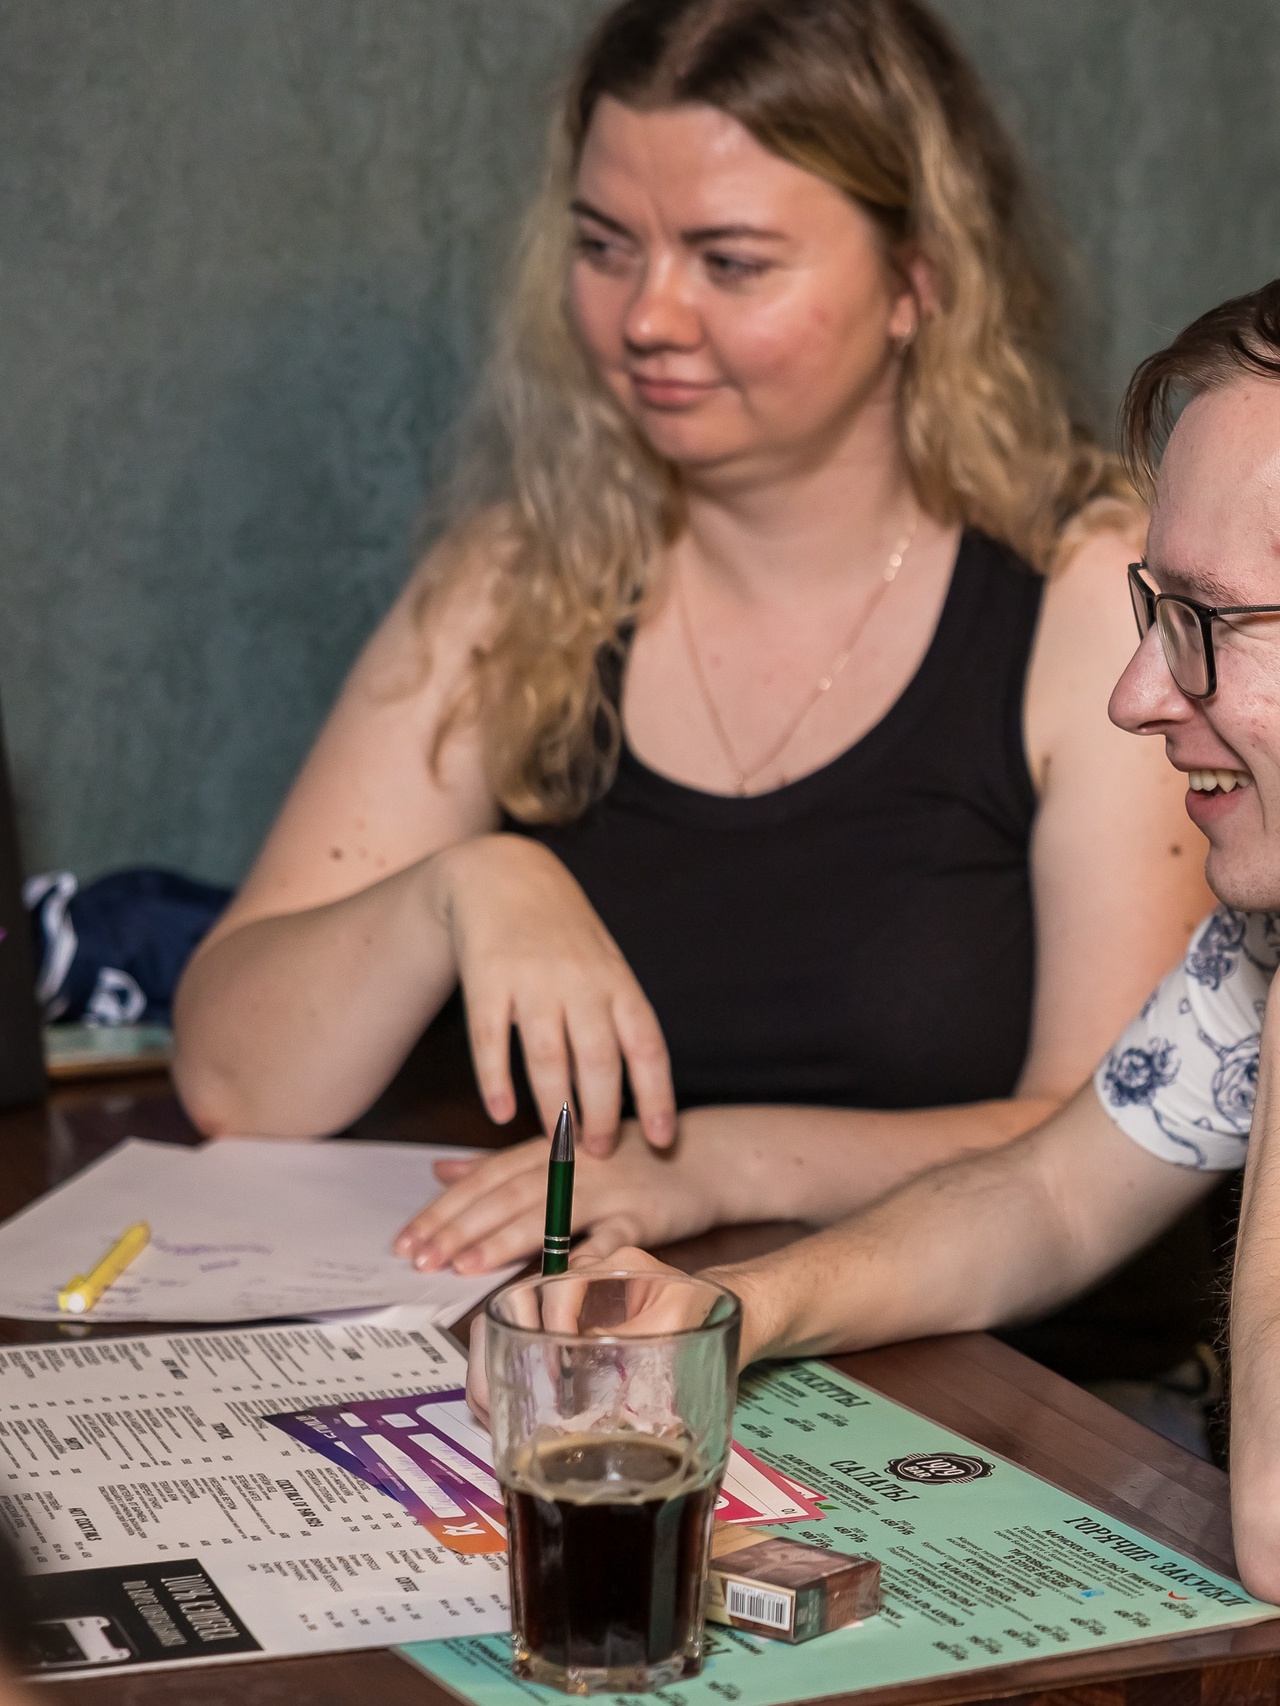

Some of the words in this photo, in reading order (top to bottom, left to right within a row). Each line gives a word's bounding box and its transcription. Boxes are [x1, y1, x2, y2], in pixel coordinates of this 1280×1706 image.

[904, 1465, 932, 1478] BAR
[916, 1459, 965, 1477] 1929
[274, 1479, 304, 1501] COCKTAILS
[829, 1459, 920, 1502] САЛАТЫ
[65, 1507, 88, 1517] HOT
[70, 1517, 106, 1541] COCKTAILS
[1060, 1515, 1161, 1563] ГОРЯЧИЕ
[1146, 1559, 1252, 1609] ЗАКУСКИ
